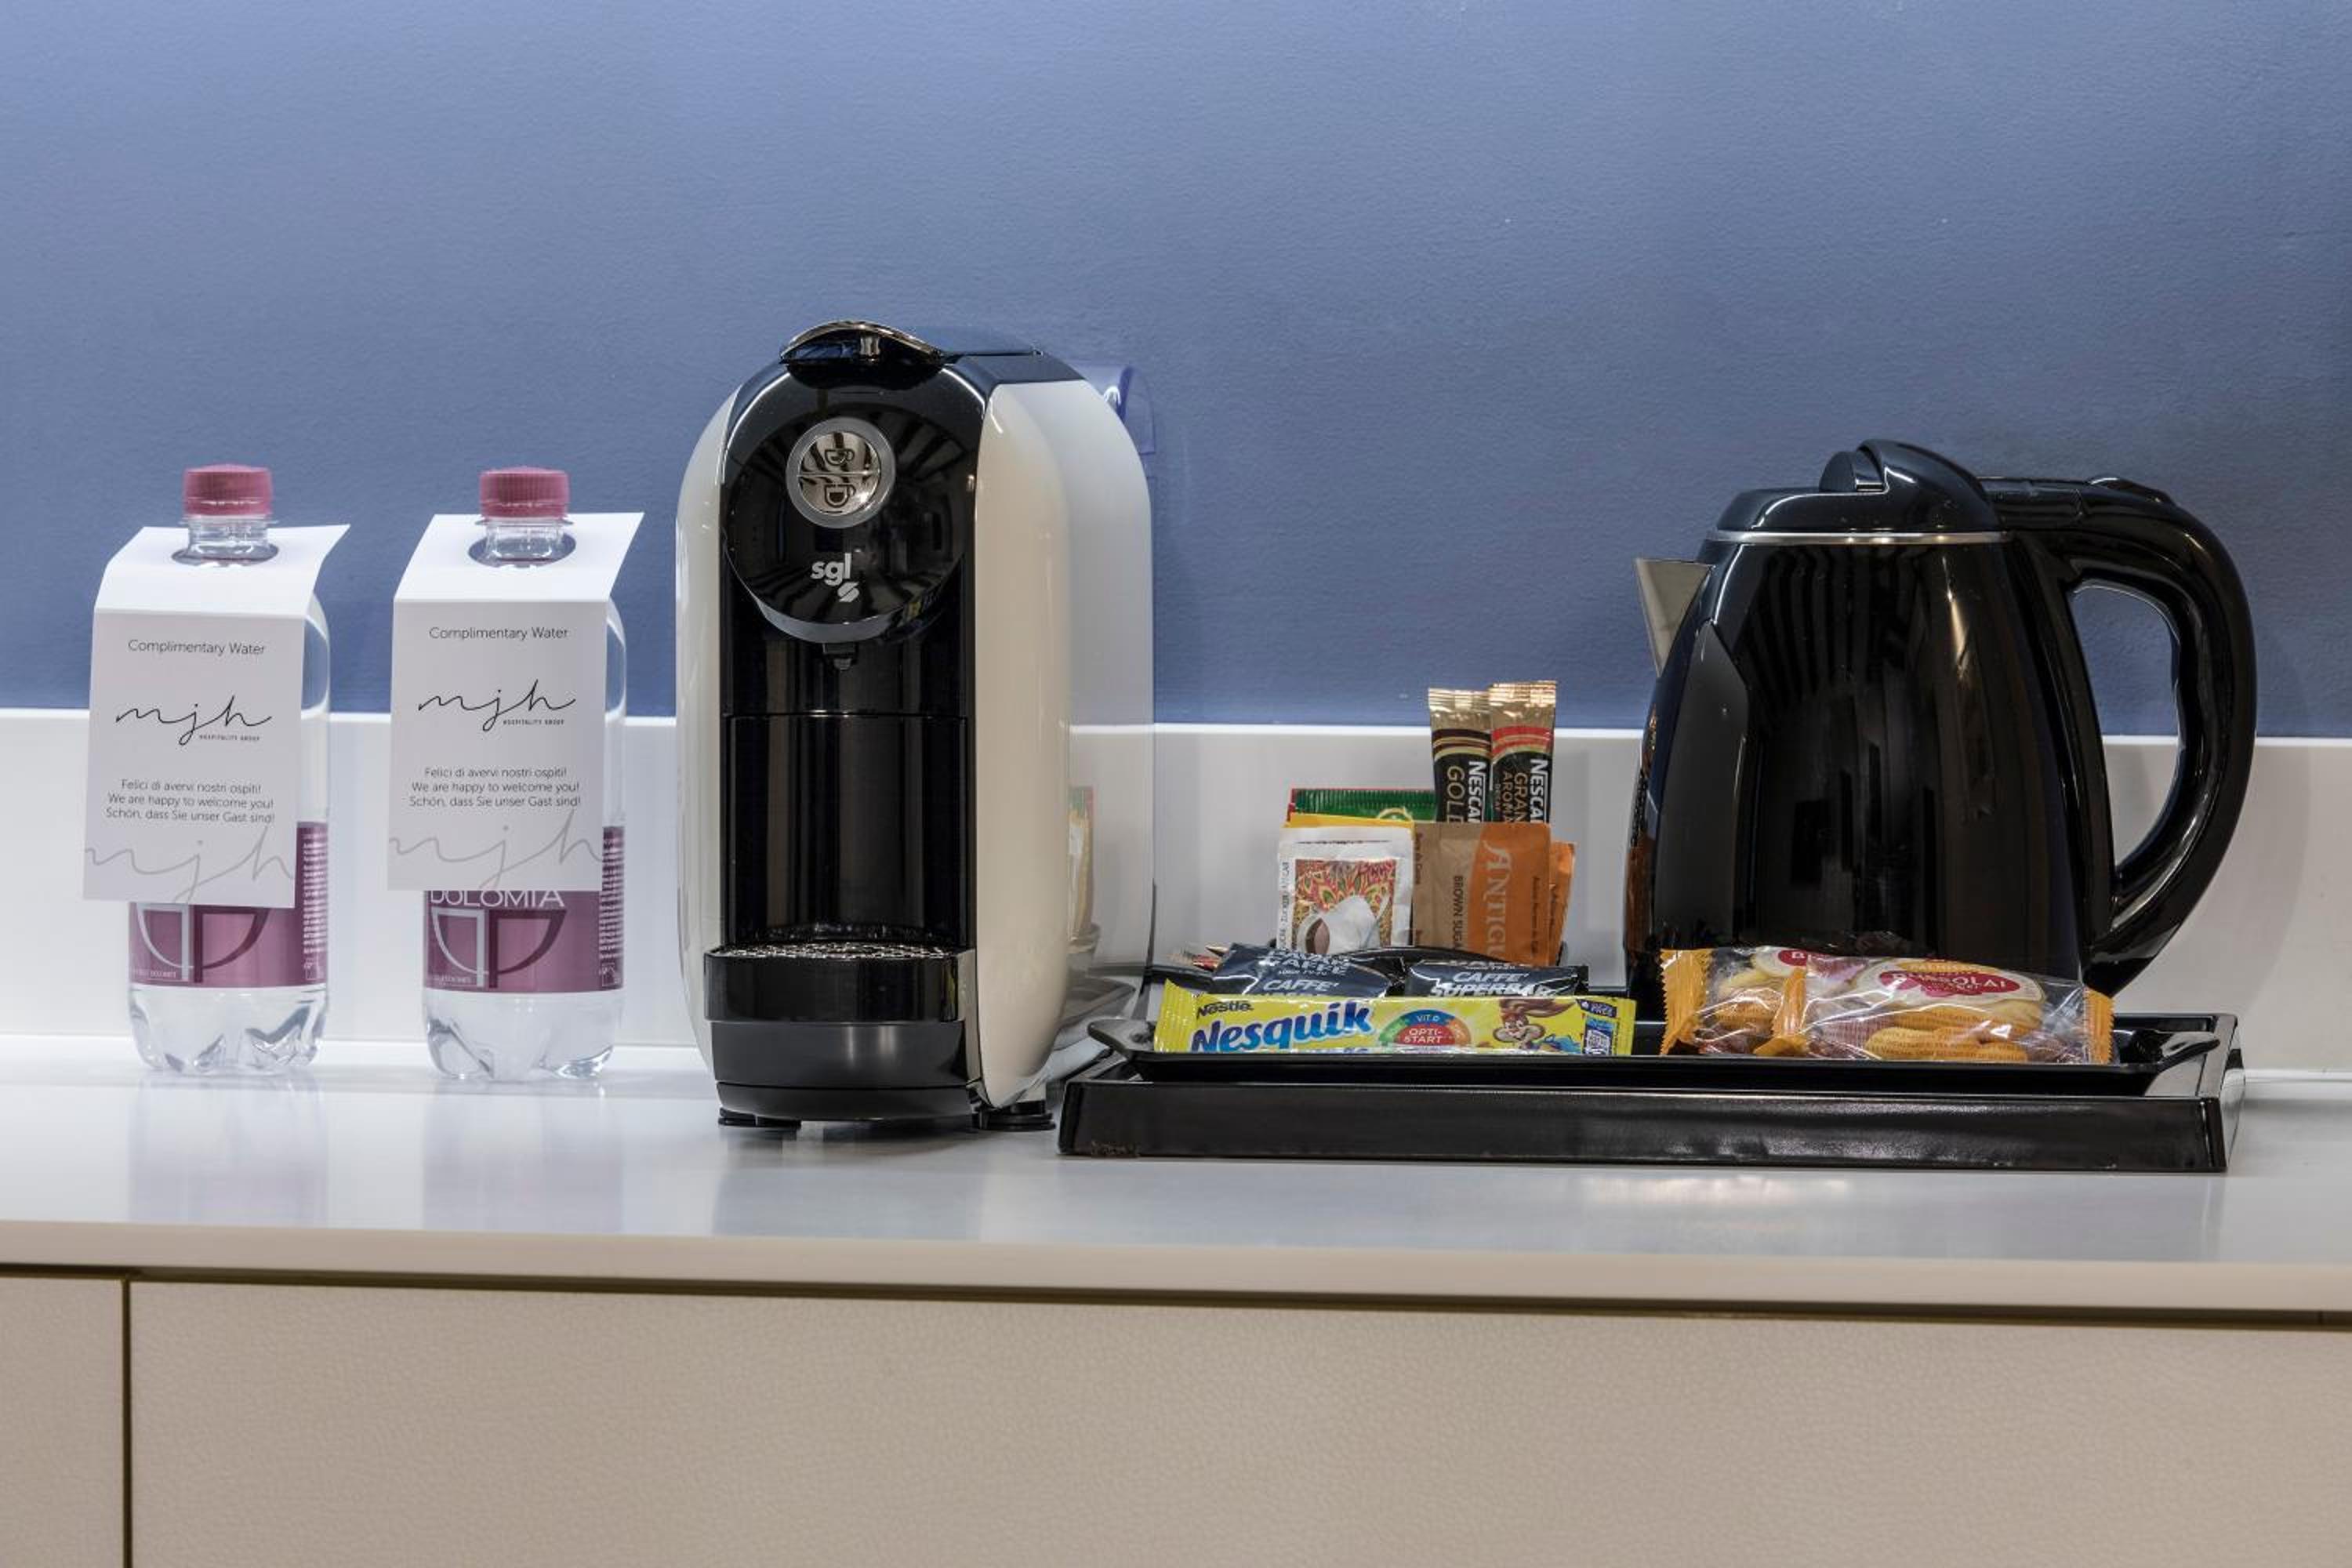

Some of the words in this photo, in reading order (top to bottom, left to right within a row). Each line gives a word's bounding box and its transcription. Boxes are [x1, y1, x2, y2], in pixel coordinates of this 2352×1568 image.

[811, 553, 851, 586] sgl
[430, 626, 528, 641] Complimentary
[532, 627, 568, 639] Water
[128, 639, 225, 657] Complimentary
[229, 643, 265, 655] Water
[425, 766, 452, 779] Felici
[455, 766, 465, 778] di
[468, 768, 498, 778] avervi
[501, 768, 532, 778] nostri
[535, 766, 567, 780] ospiti!
[122, 779, 148, 791] Felici
[151, 781, 161, 791] di
[164, 782, 194, 792] avervi
[198, 782, 227, 793] nostri
[412, 782, 430, 792] We
[452, 782, 485, 795] happy
[488, 782, 499, 792] to
[503, 782, 553, 792] welcome
[556, 782, 579, 795] you!
[108, 793, 125, 804] We
[129, 795, 144, 804] are
[149, 794, 180, 808] happy
[183, 797, 194, 807] to
[198, 797, 247, 808] welcome
[250, 798, 274, 811] you!
[449, 796, 474, 807] dass
[477, 796, 492, 807] Sie
[495, 797, 525, 807] unser
[528, 796, 553, 807] Gast
[556, 796, 581, 807] sind!
[145, 808, 169, 820] dass
[172, 810, 187, 821] Sie
[191, 811, 220, 821] unser
[223, 811, 247, 822] Gast
[431, 889, 565, 908] DOLOMIA
[1453, 875, 1464, 916] BROWN
[1190, 1002, 1372, 1052] Nesquik
